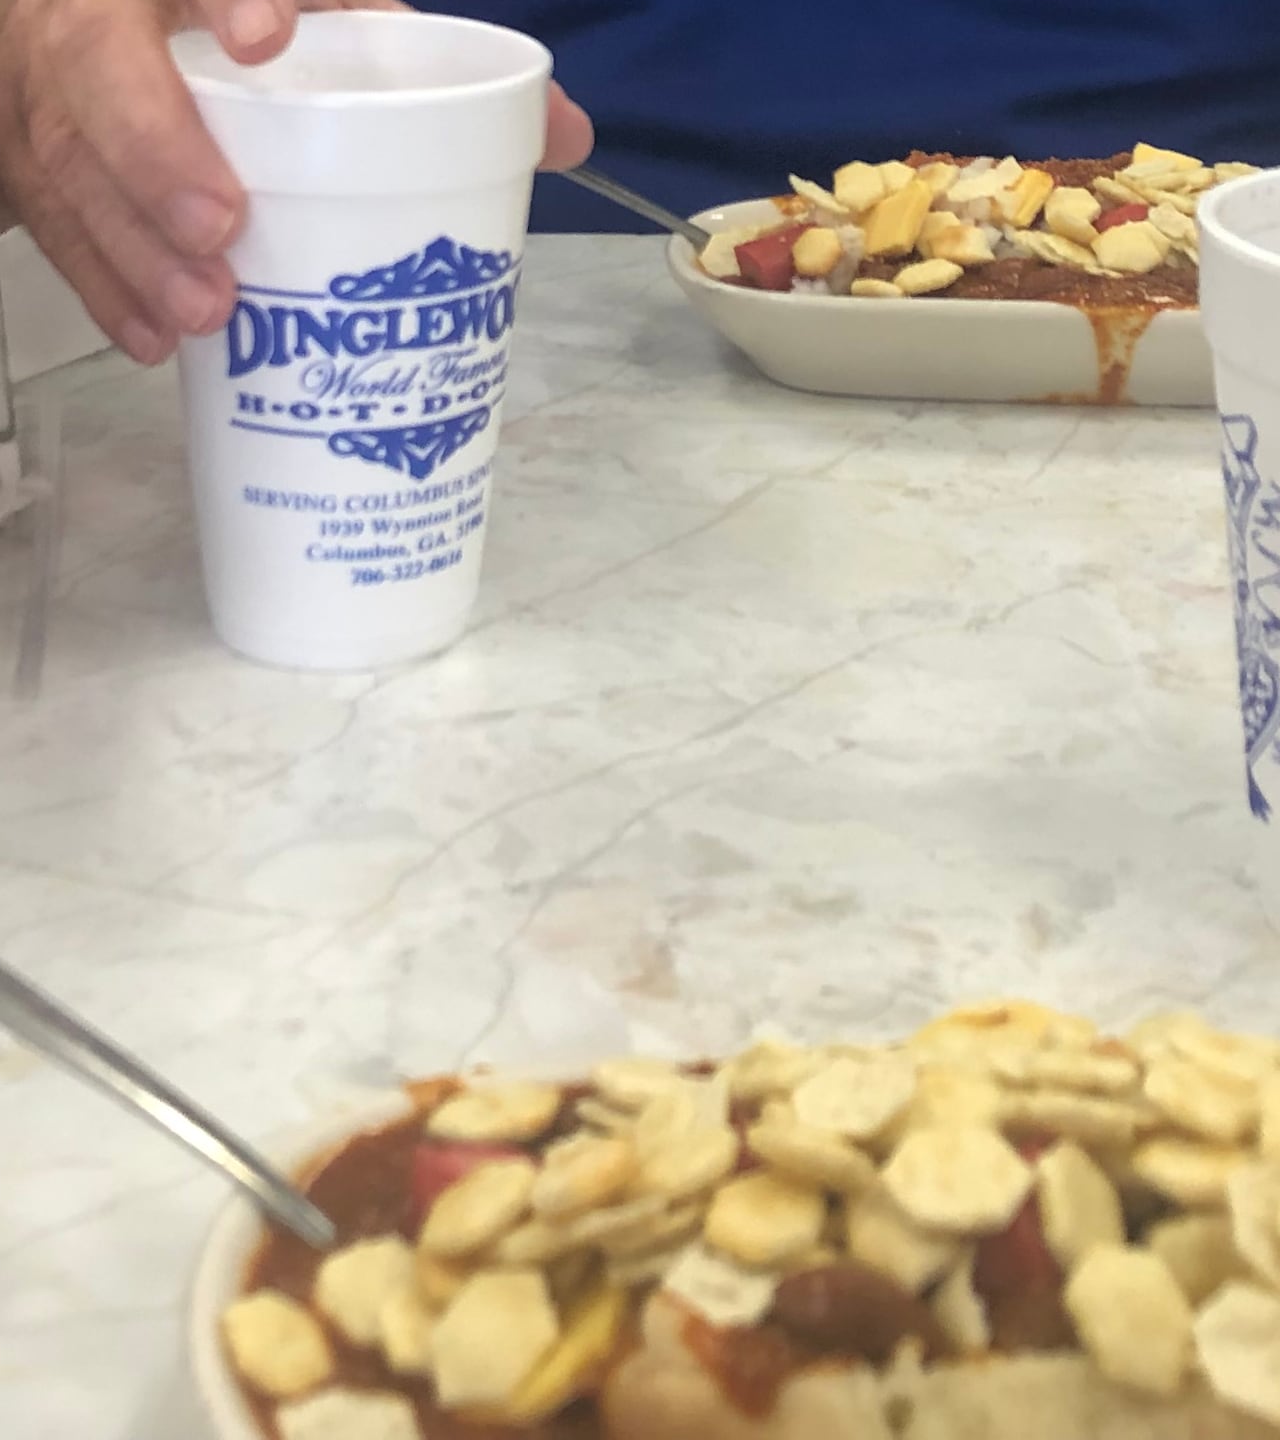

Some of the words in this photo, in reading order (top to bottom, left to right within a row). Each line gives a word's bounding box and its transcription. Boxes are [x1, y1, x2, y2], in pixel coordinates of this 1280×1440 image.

[300, 352, 421, 399] World
[243, 484, 338, 513] SERVING
[344, 478, 466, 513] COLUMBUS
[319, 519, 365, 538] 1939
[370, 507, 453, 539] Wynnton
